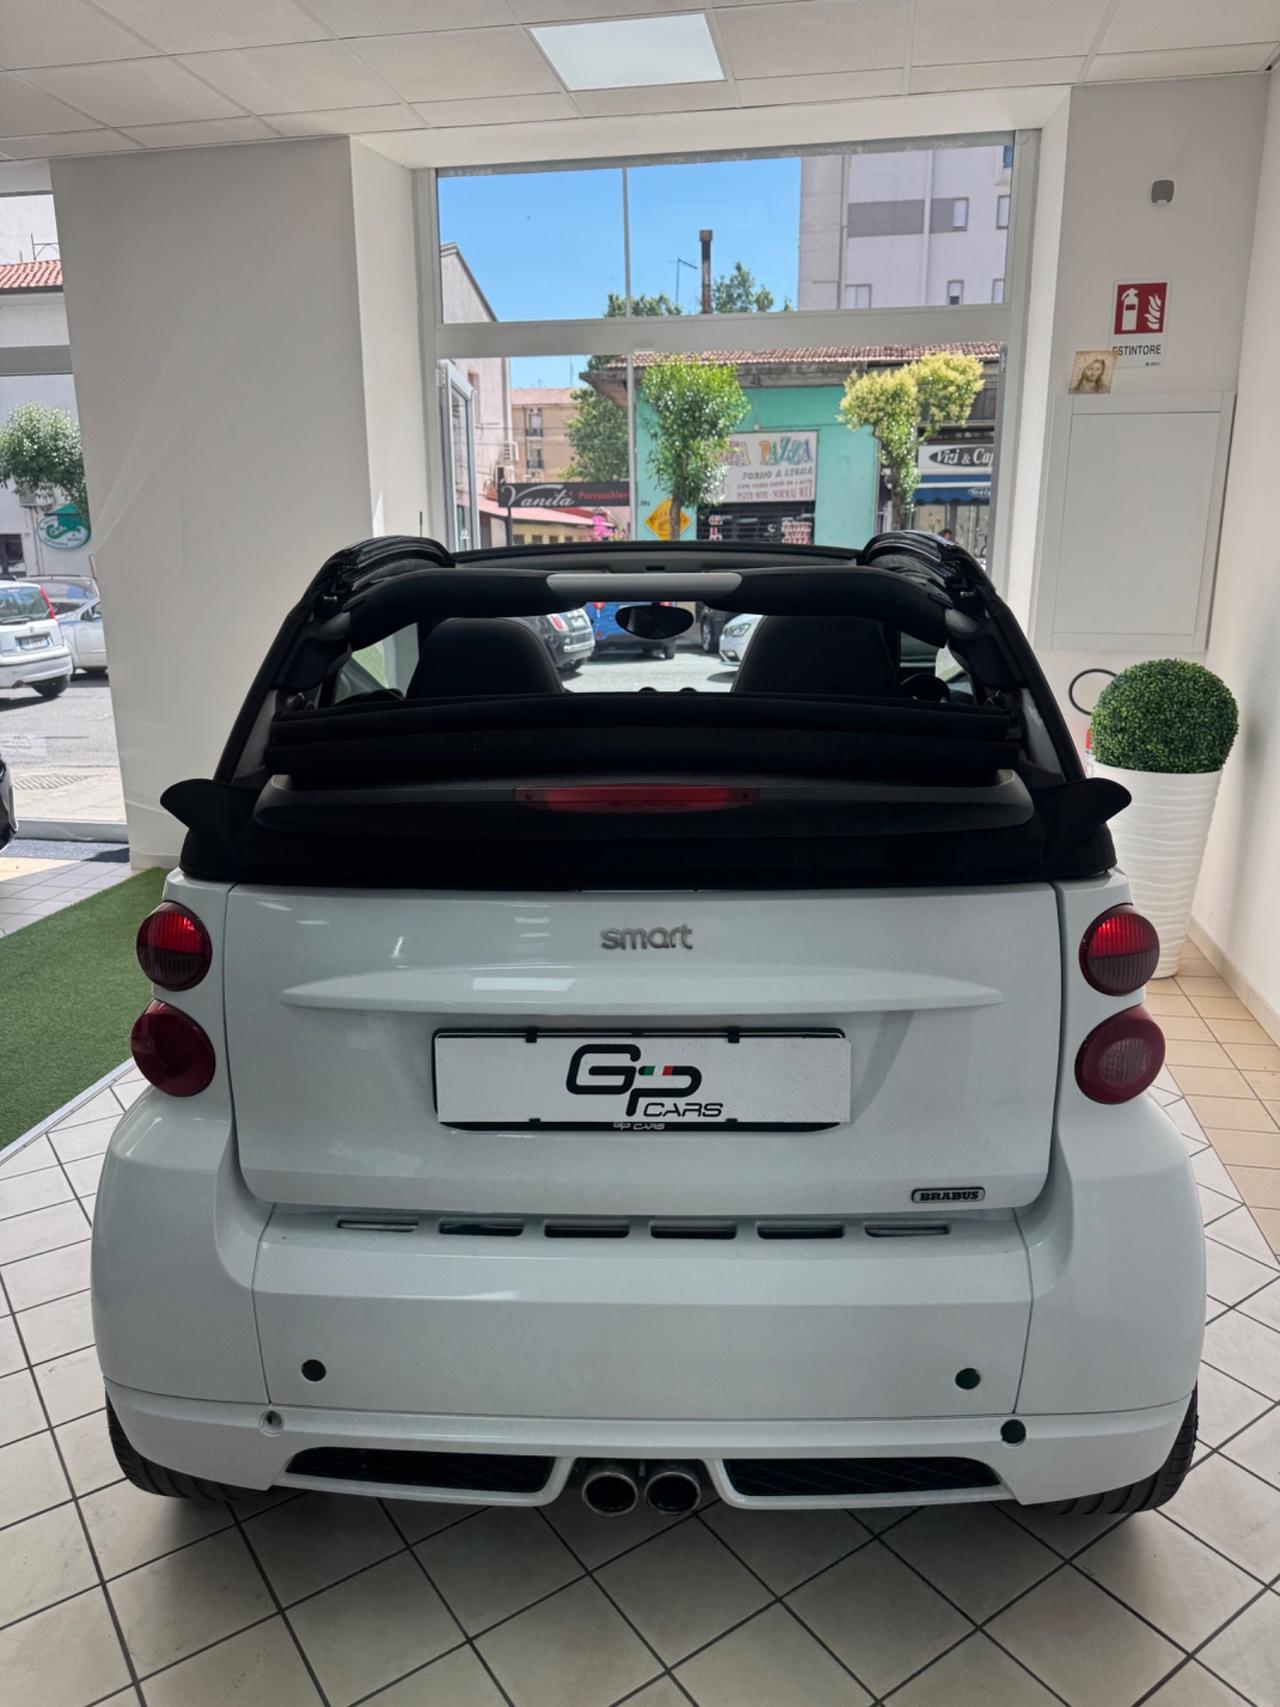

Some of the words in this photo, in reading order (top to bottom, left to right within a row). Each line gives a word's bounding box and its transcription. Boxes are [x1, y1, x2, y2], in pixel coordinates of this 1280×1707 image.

[936, 449, 960, 464] Vizi
[961, 453, 971, 465] &
[600, 924, 694, 951] smart
[565, 1043, 703, 1118] GP
[643, 1102, 724, 1118] CARS
[920, 1191, 980, 1201] BRABUS
